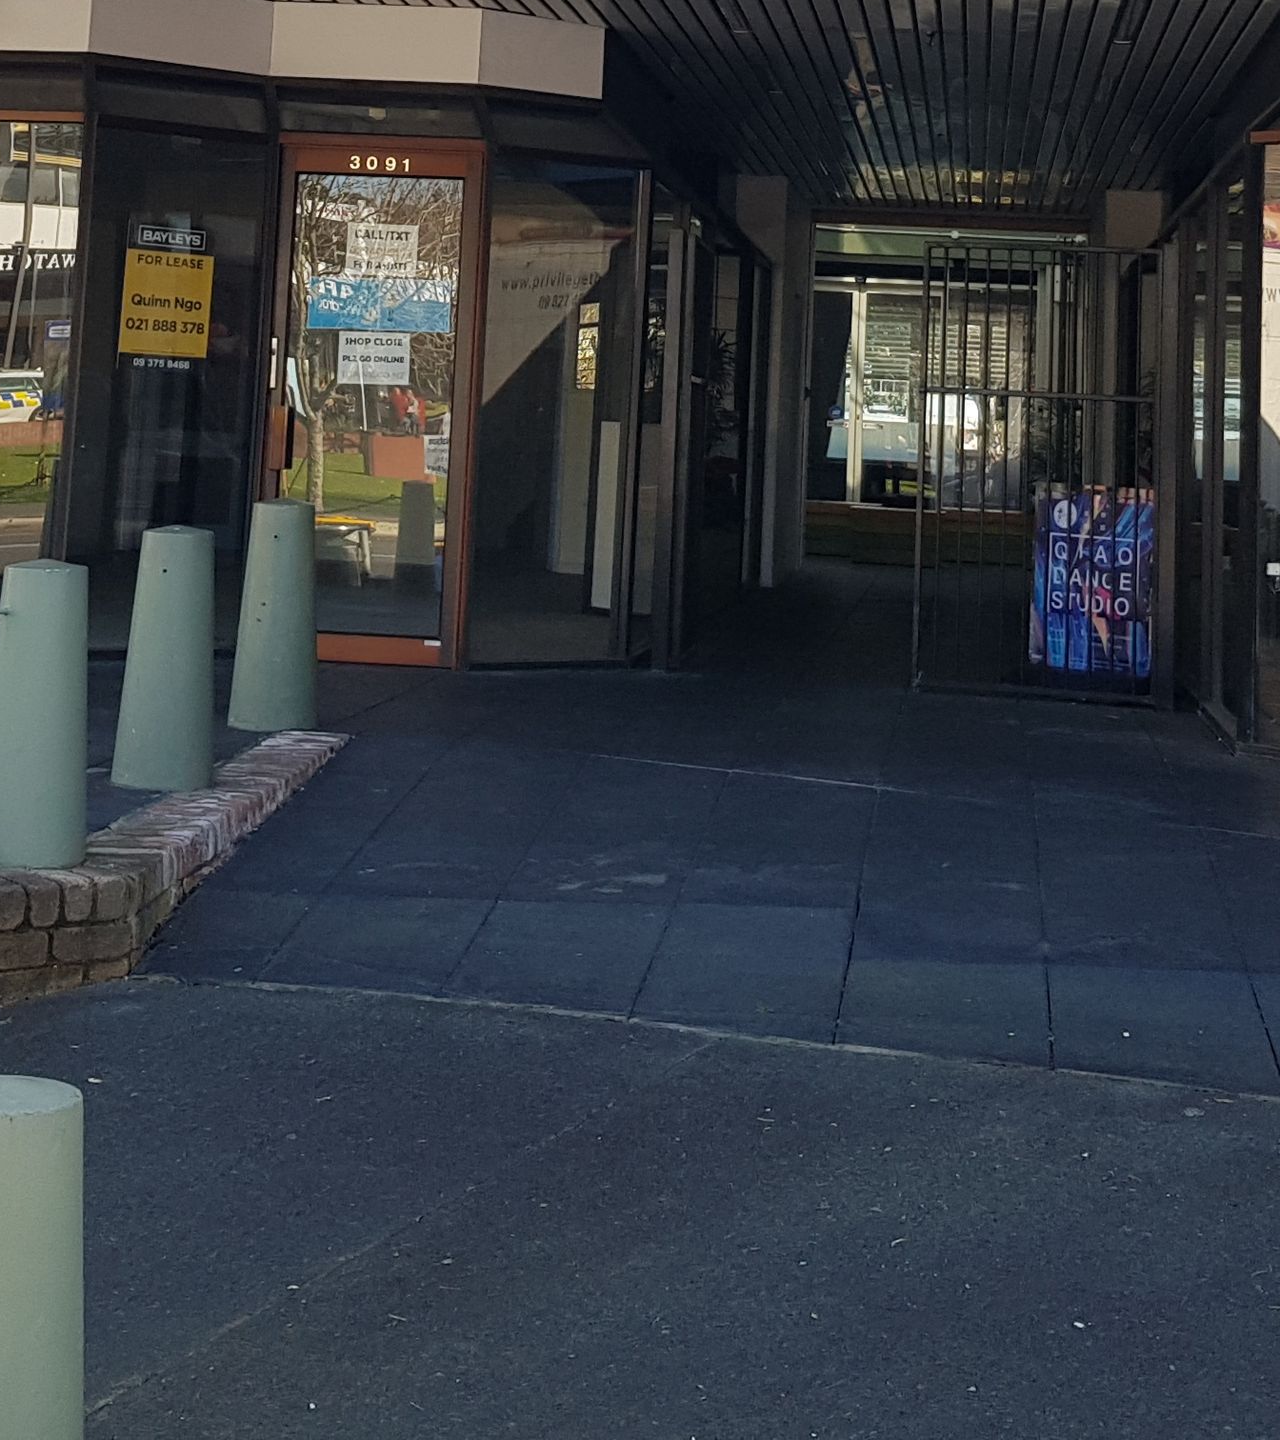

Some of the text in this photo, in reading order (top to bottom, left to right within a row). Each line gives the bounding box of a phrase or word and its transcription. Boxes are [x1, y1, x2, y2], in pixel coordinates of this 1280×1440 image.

[349, 156, 411, 172] 3091
[142, 230, 201, 246] BAYLEYS
[137, 254, 204, 269] FOR LEASE
[131, 293, 202, 312] Quinn Ngo
[126, 317, 205, 335] 021 888 378
[345, 337, 403, 347] SHOP CLOSE
[1054, 541, 1133, 565] QIAO
[1053, 567, 1132, 591] DANCE
[1051, 591, 1130, 616] STUDIO
